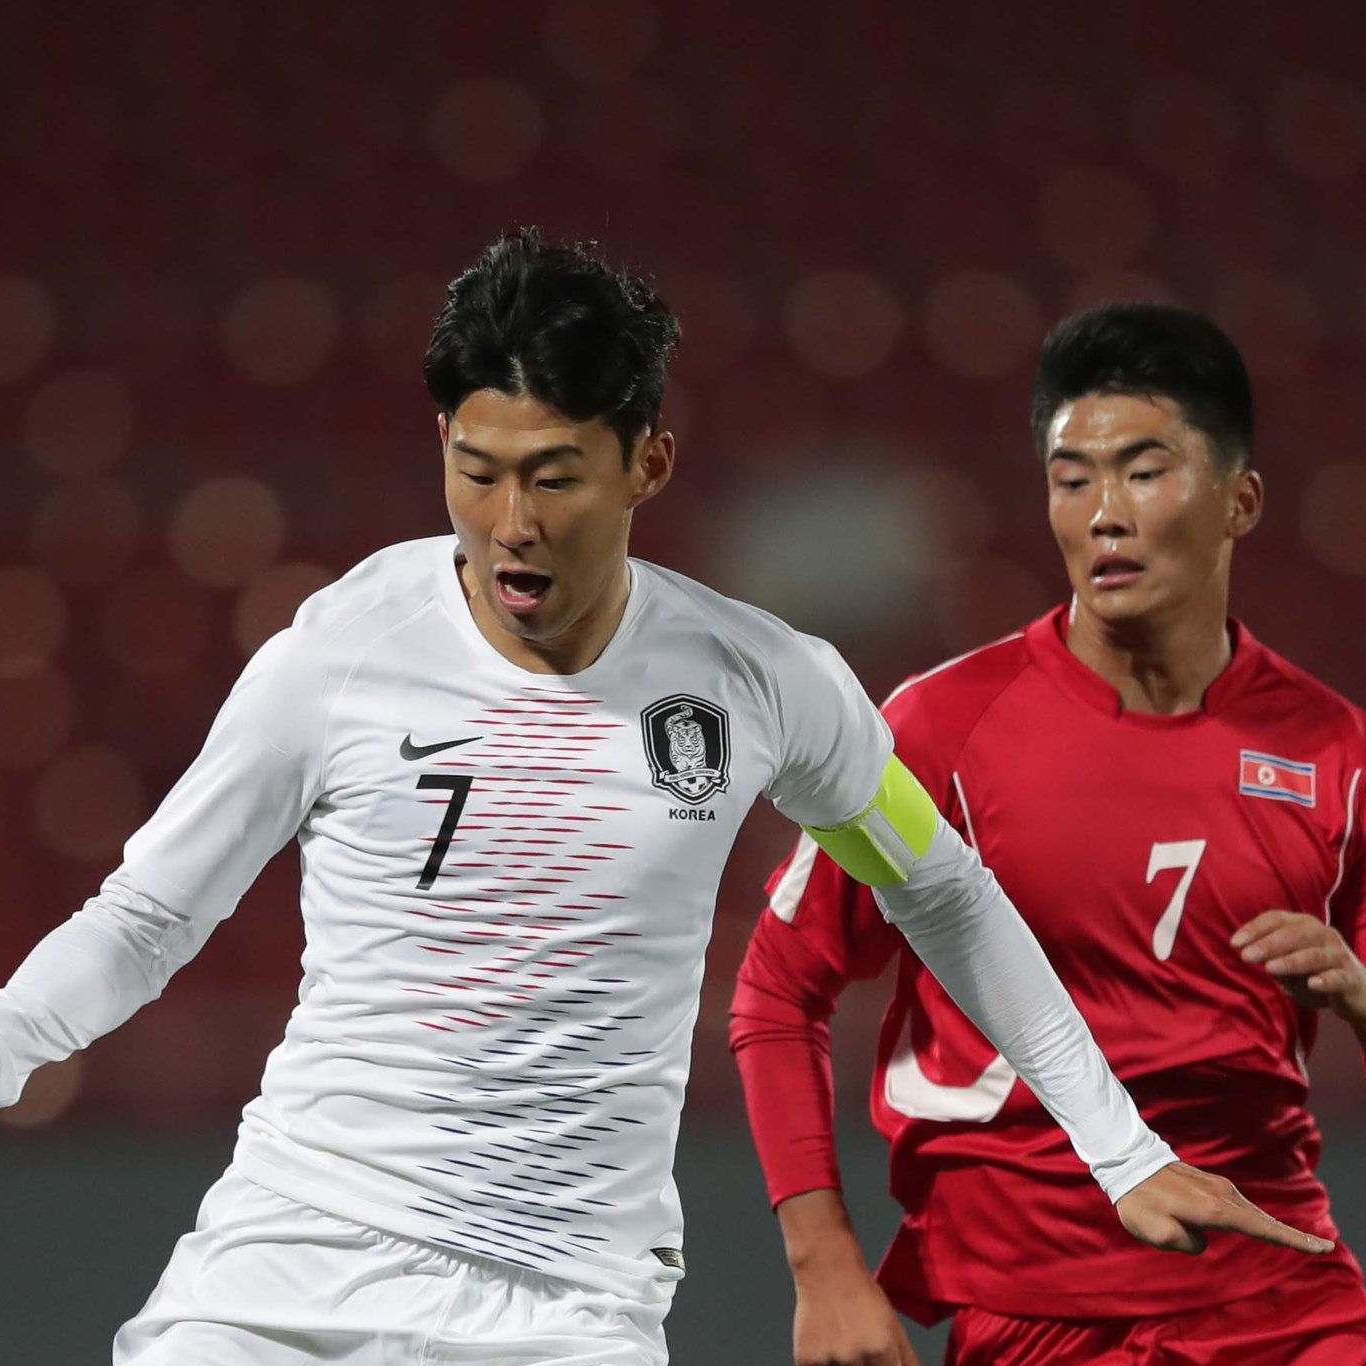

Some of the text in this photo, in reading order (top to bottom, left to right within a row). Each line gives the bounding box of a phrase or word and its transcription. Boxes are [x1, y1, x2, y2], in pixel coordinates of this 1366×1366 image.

[415, 774, 474, 891] 7
[669, 808, 715, 821] KOREA
[1145, 839, 1207, 962] 7
